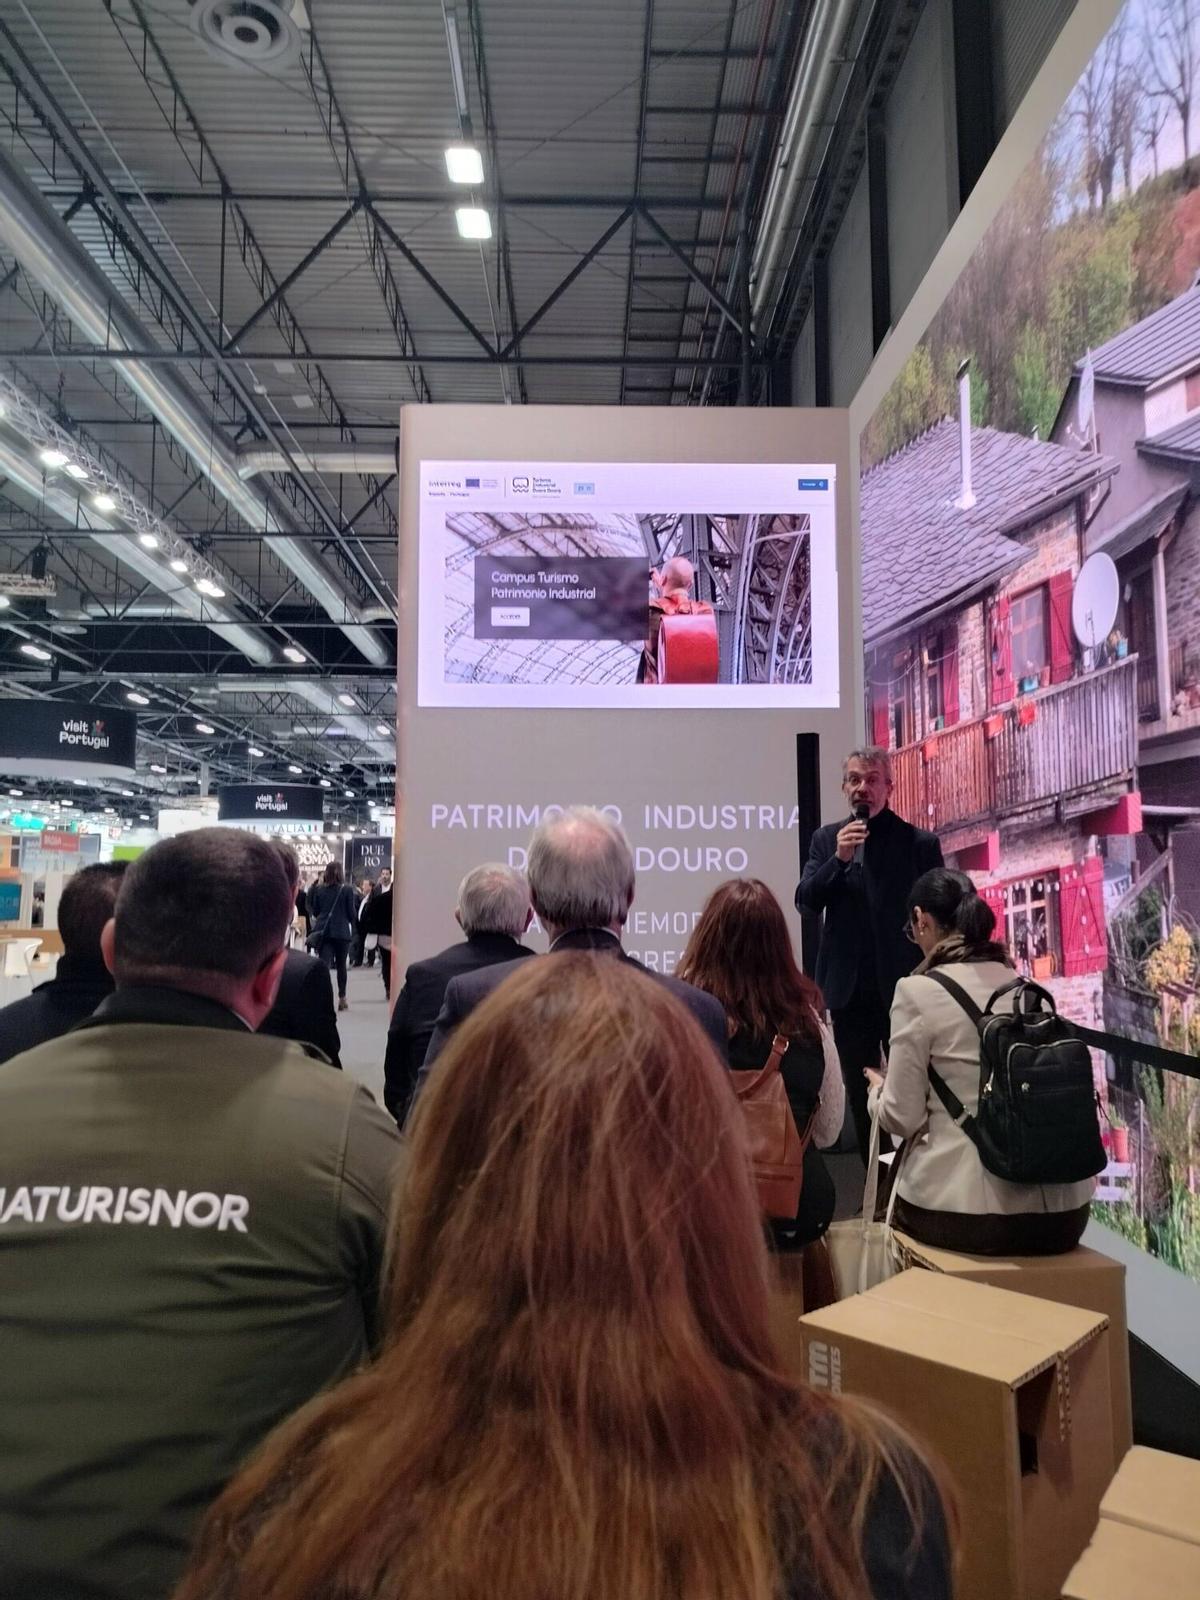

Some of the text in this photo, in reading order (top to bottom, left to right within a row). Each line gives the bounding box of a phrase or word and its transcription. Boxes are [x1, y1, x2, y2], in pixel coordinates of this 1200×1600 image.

[491, 571, 579, 586] Campus Turismo
[491, 587, 596, 600] Patrimonio Industrial
[62, 719, 89, 733] visit
[59, 731, 110, 750] Portugal
[256, 794, 273, 803] visit
[255, 802, 288, 812] Portugal
[634, 846, 749, 872] DOURO
[0, 1185, 249, 1233] ATURISNOR
